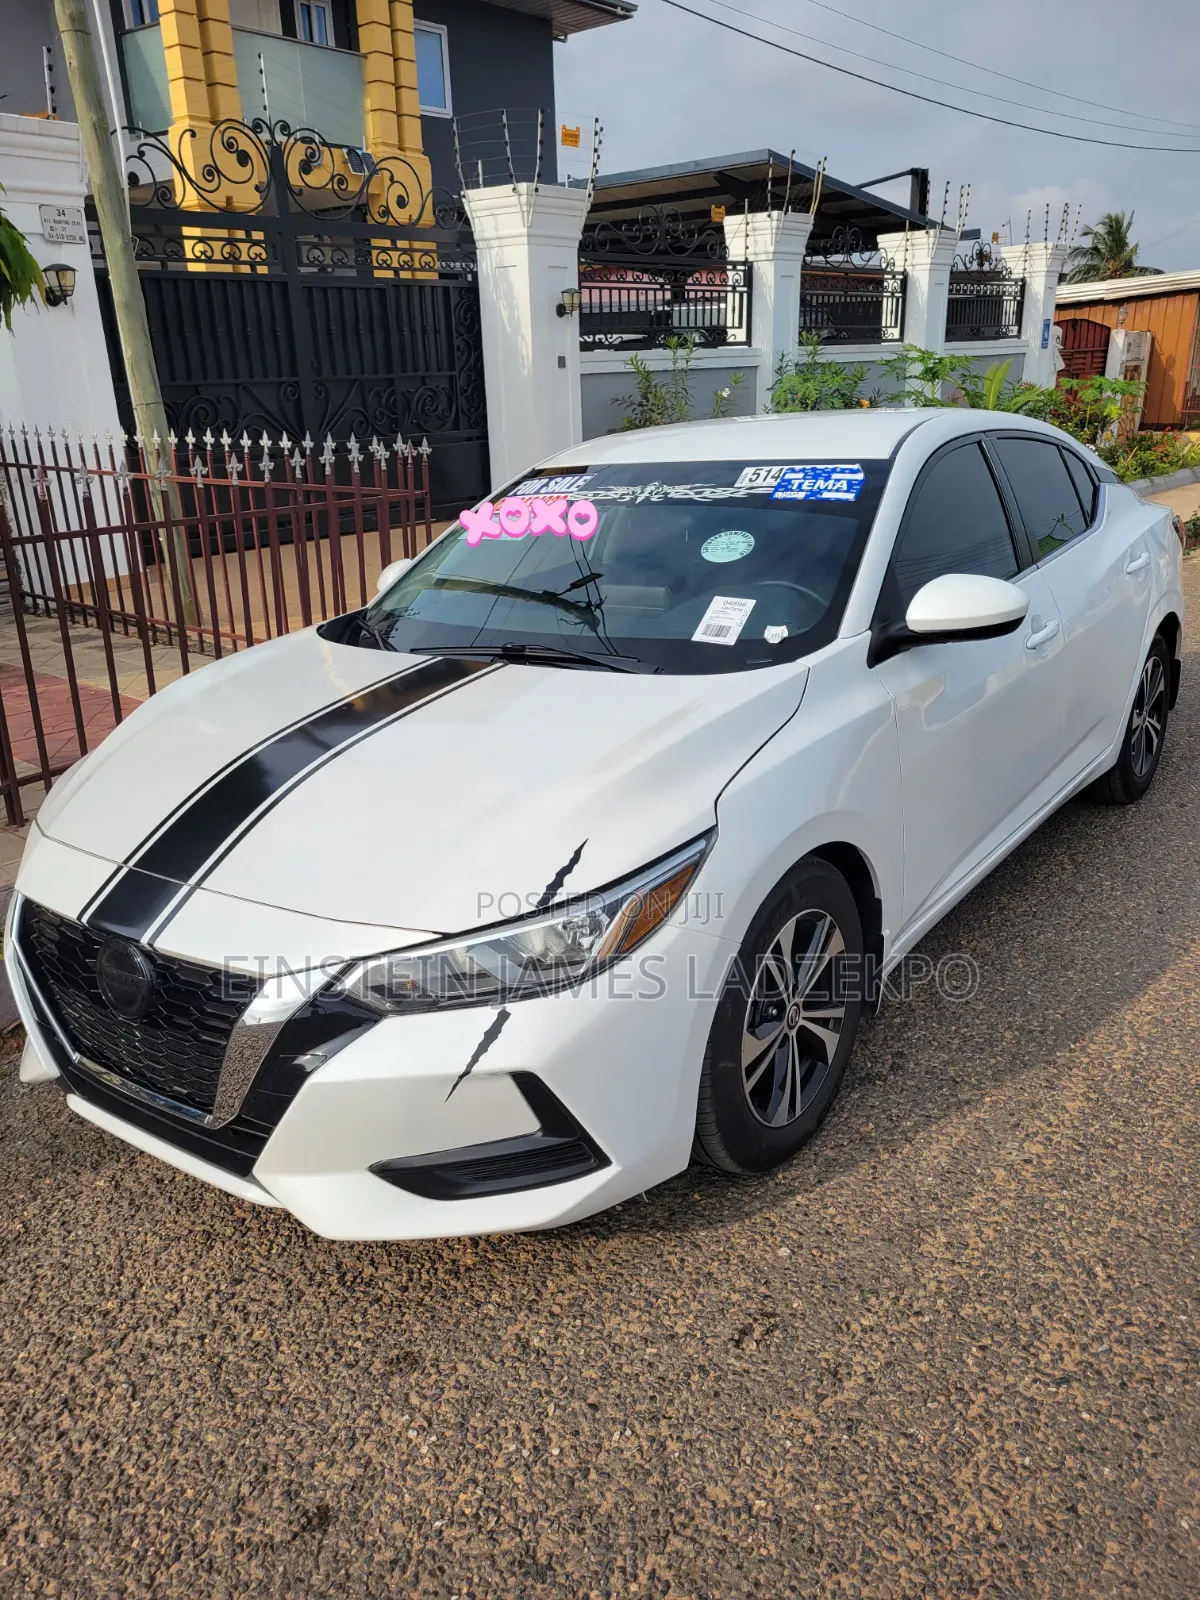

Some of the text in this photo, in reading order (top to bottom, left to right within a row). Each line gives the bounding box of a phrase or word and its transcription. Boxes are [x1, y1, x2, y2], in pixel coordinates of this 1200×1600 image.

[56, 209, 66, 217] 34
[749, 468, 784, 483] 514
[507, 475, 593, 497] FOR SALE
[790, 479, 848, 490] TEMA
